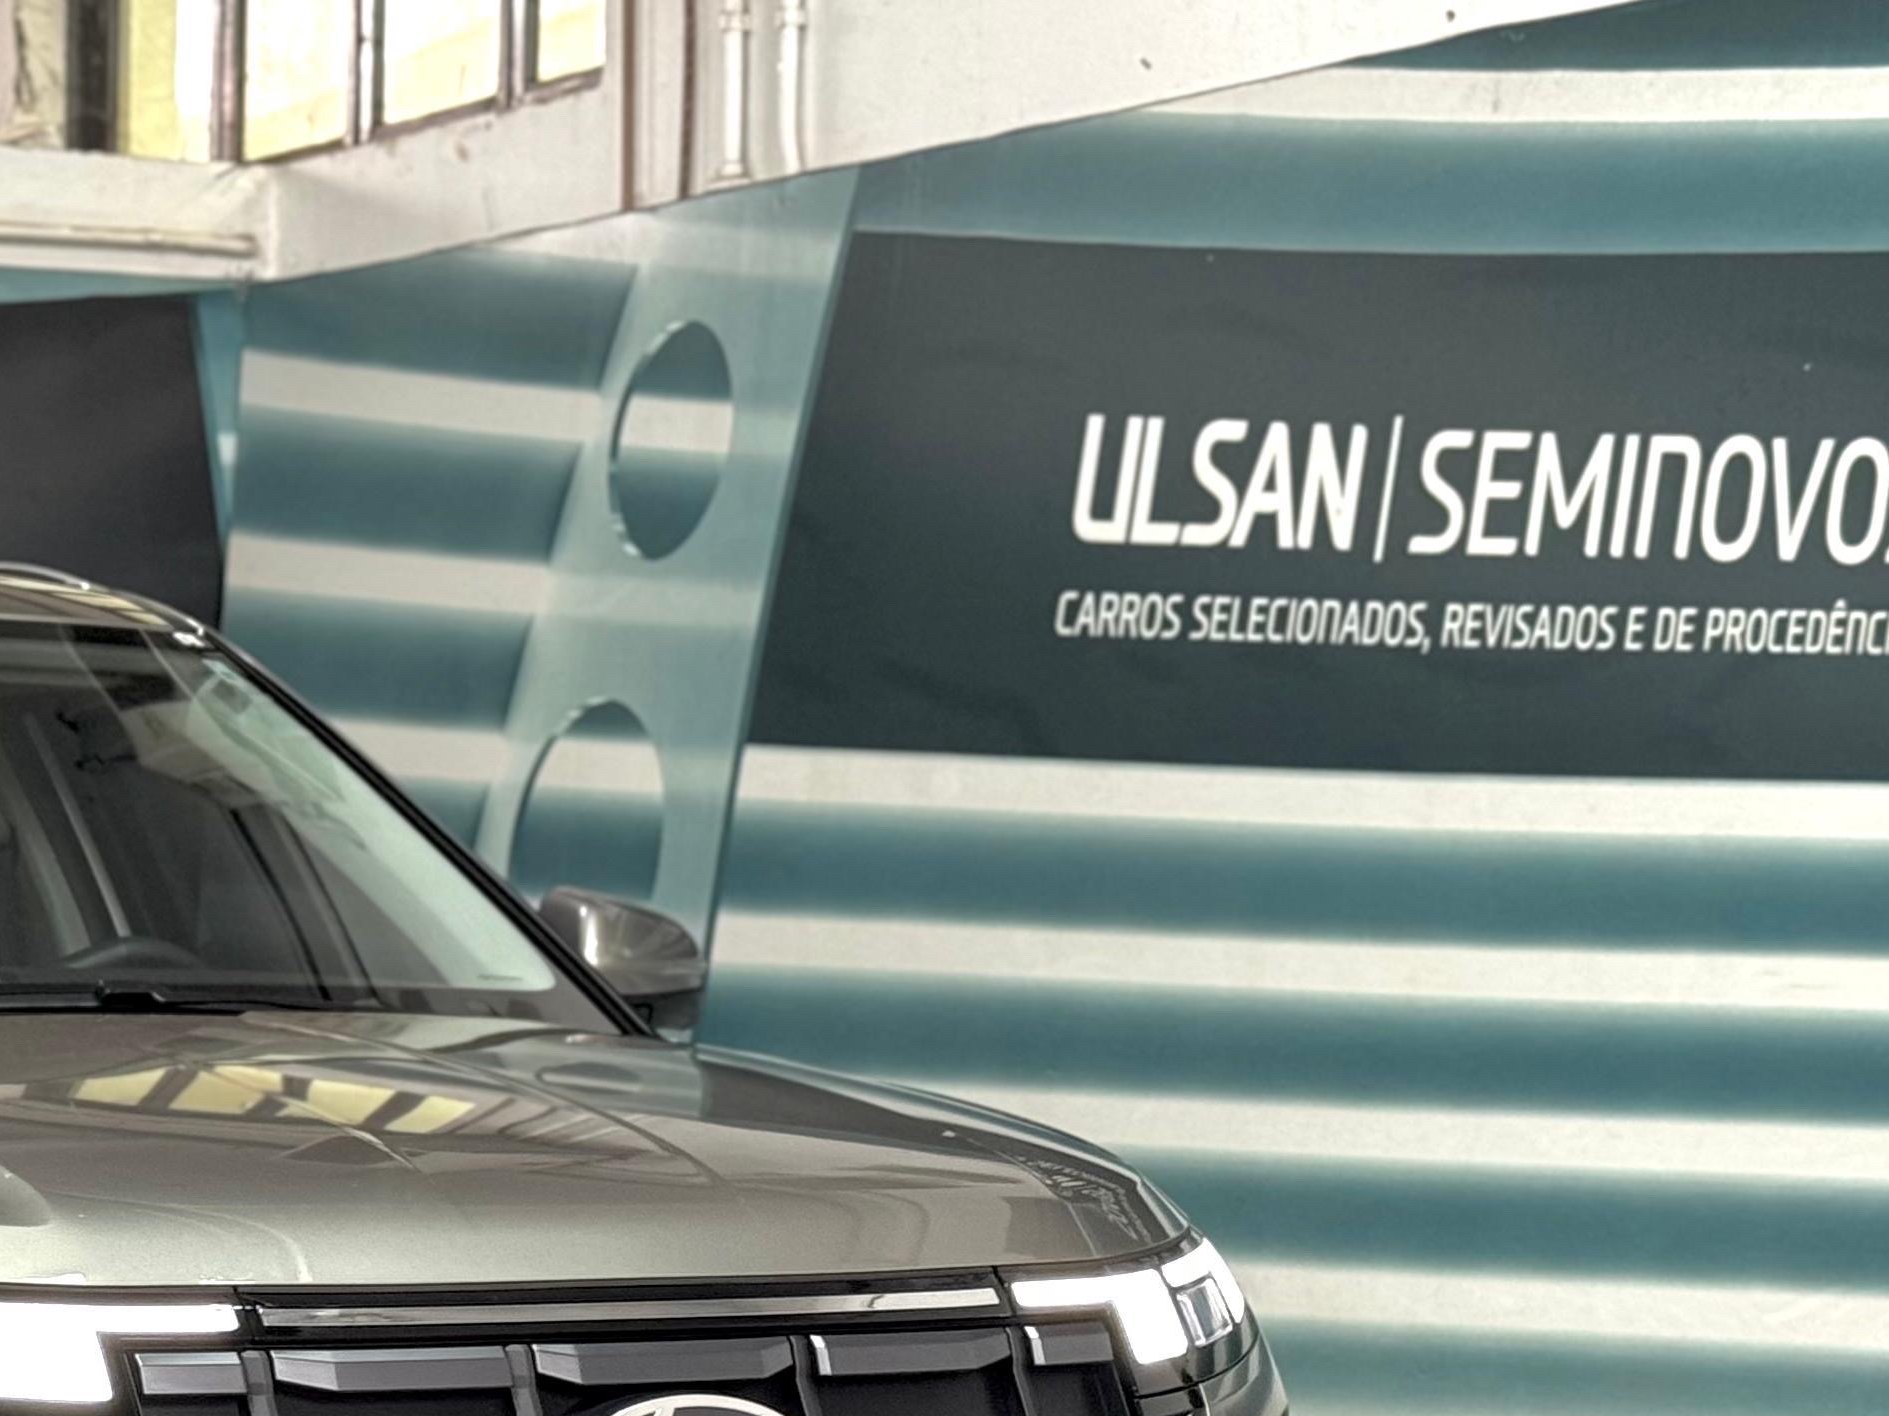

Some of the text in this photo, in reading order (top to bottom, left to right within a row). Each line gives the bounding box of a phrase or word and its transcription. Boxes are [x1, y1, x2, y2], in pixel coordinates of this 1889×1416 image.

[1071, 412, 1889, 567] ULSAN SEMINOVO
[1054, 590, 1889, 656] CARROS SELECIONADOS, REVISADOS E DE PROCEDÊNC
